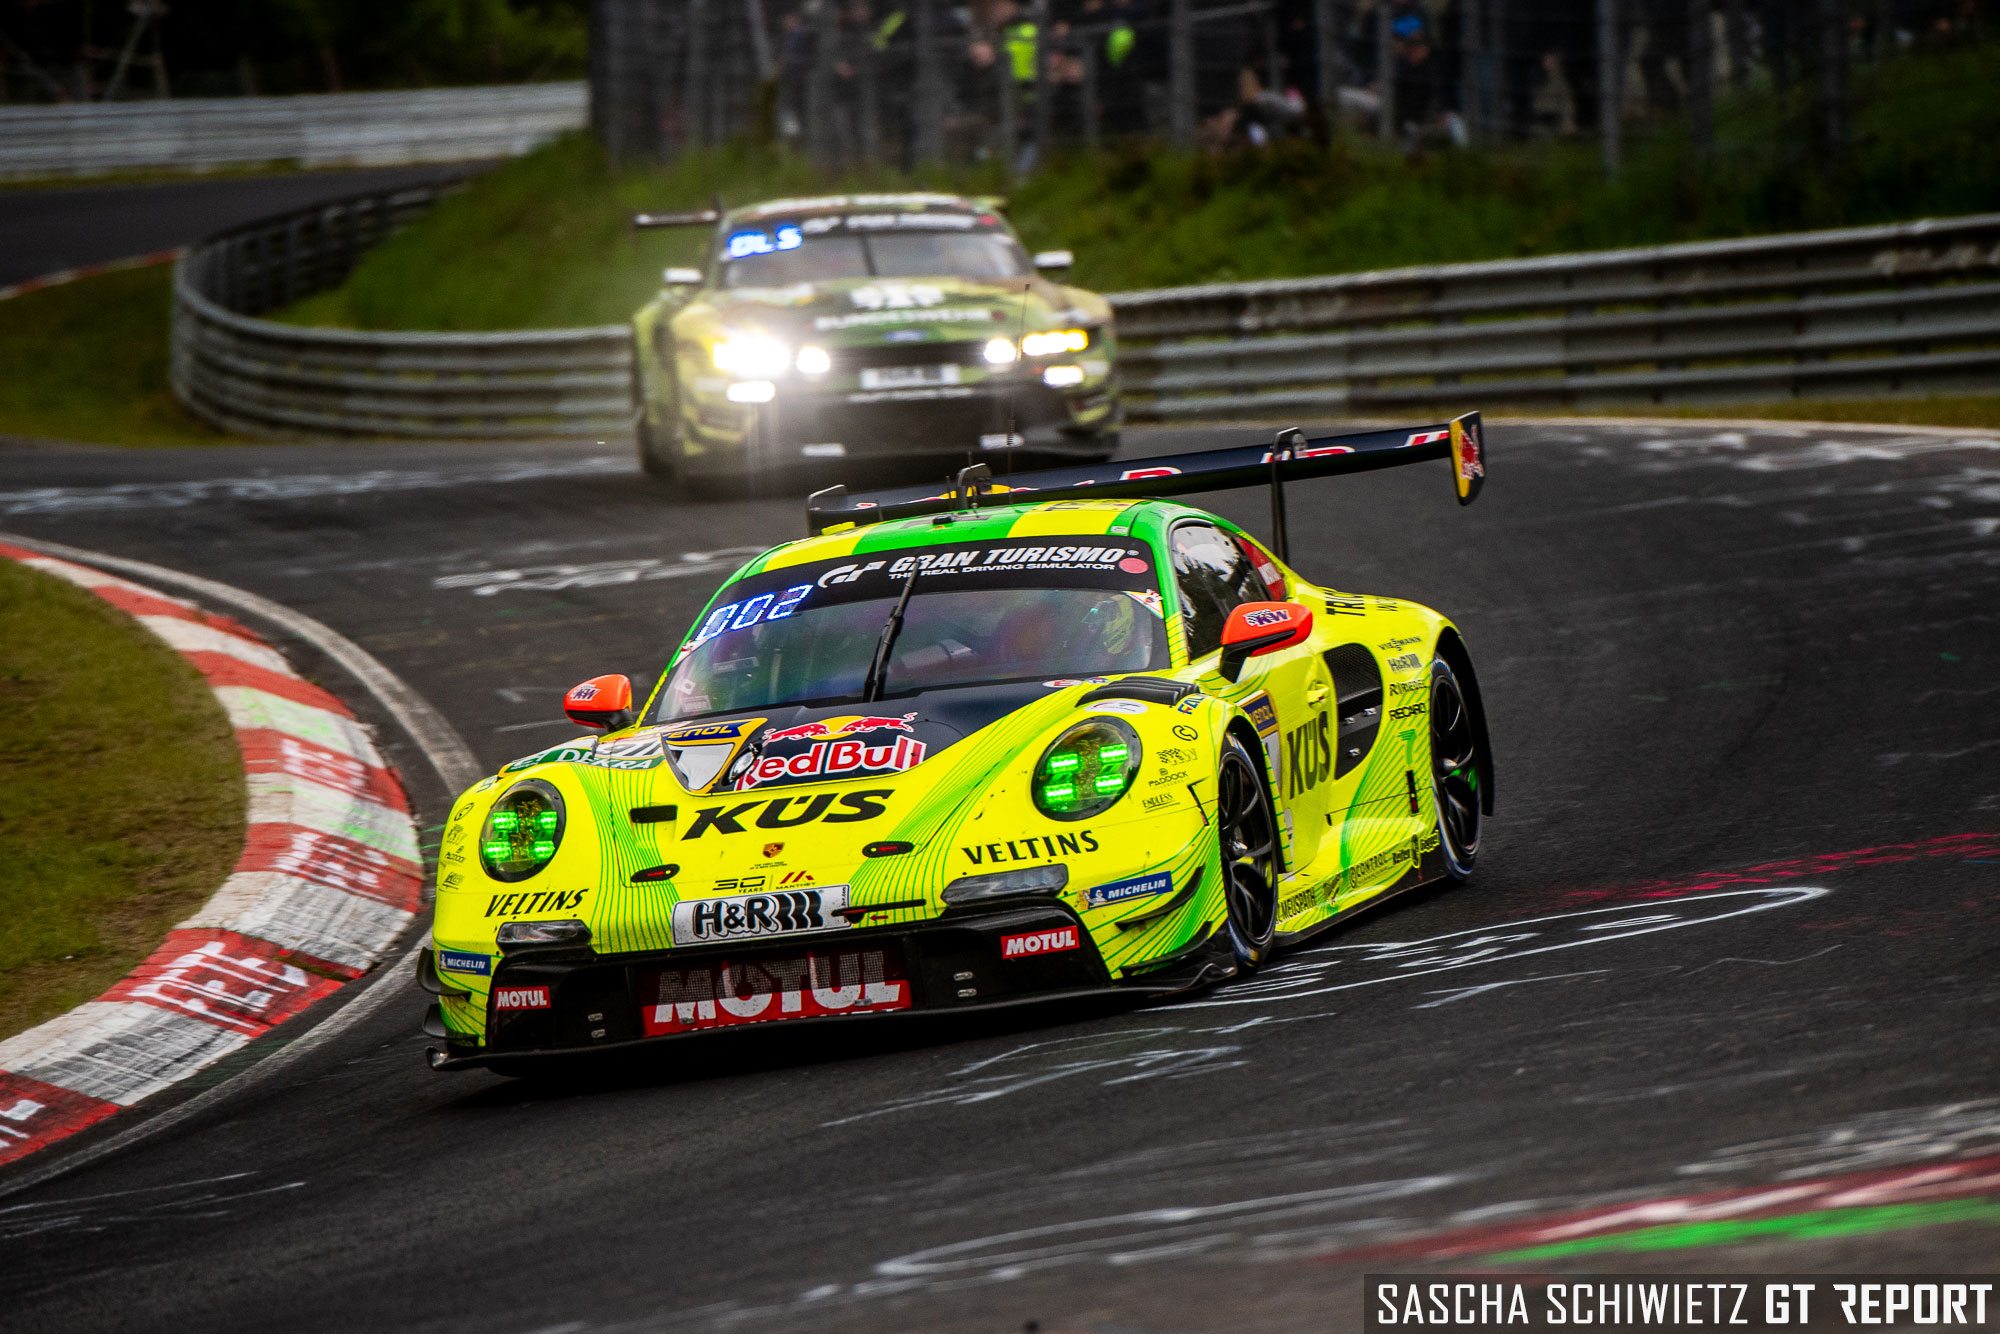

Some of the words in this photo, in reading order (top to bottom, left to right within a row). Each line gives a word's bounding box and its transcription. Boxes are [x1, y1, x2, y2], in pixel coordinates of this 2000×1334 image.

[889, 551, 979, 571] GRAN
[984, 547, 1126, 564] TURISMO
[921, 567, 959, 576] REAL
[963, 565, 1024, 573] DRIVING
[1026, 562, 1115, 570] SIMULATOR
[694, 584, 814, 641] 002
[1389, 702, 1427, 721] RECARO
[824, 735, 927, 774] Bull
[1287, 711, 1331, 800] KÜS
[681, 789, 896, 841] KÜS
[961, 830, 1099, 865] VELTINS
[484, 889, 590, 918] VELTINS
[1108, 879, 1165, 899] MICHELIN
[693, 896, 779, 940] H&R
[1005, 930, 1076, 956] MOTUL
[447, 957, 486, 969] MICHELIN
[496, 990, 548, 1008] MOTUL
[653, 951, 902, 1020] MOTUL
